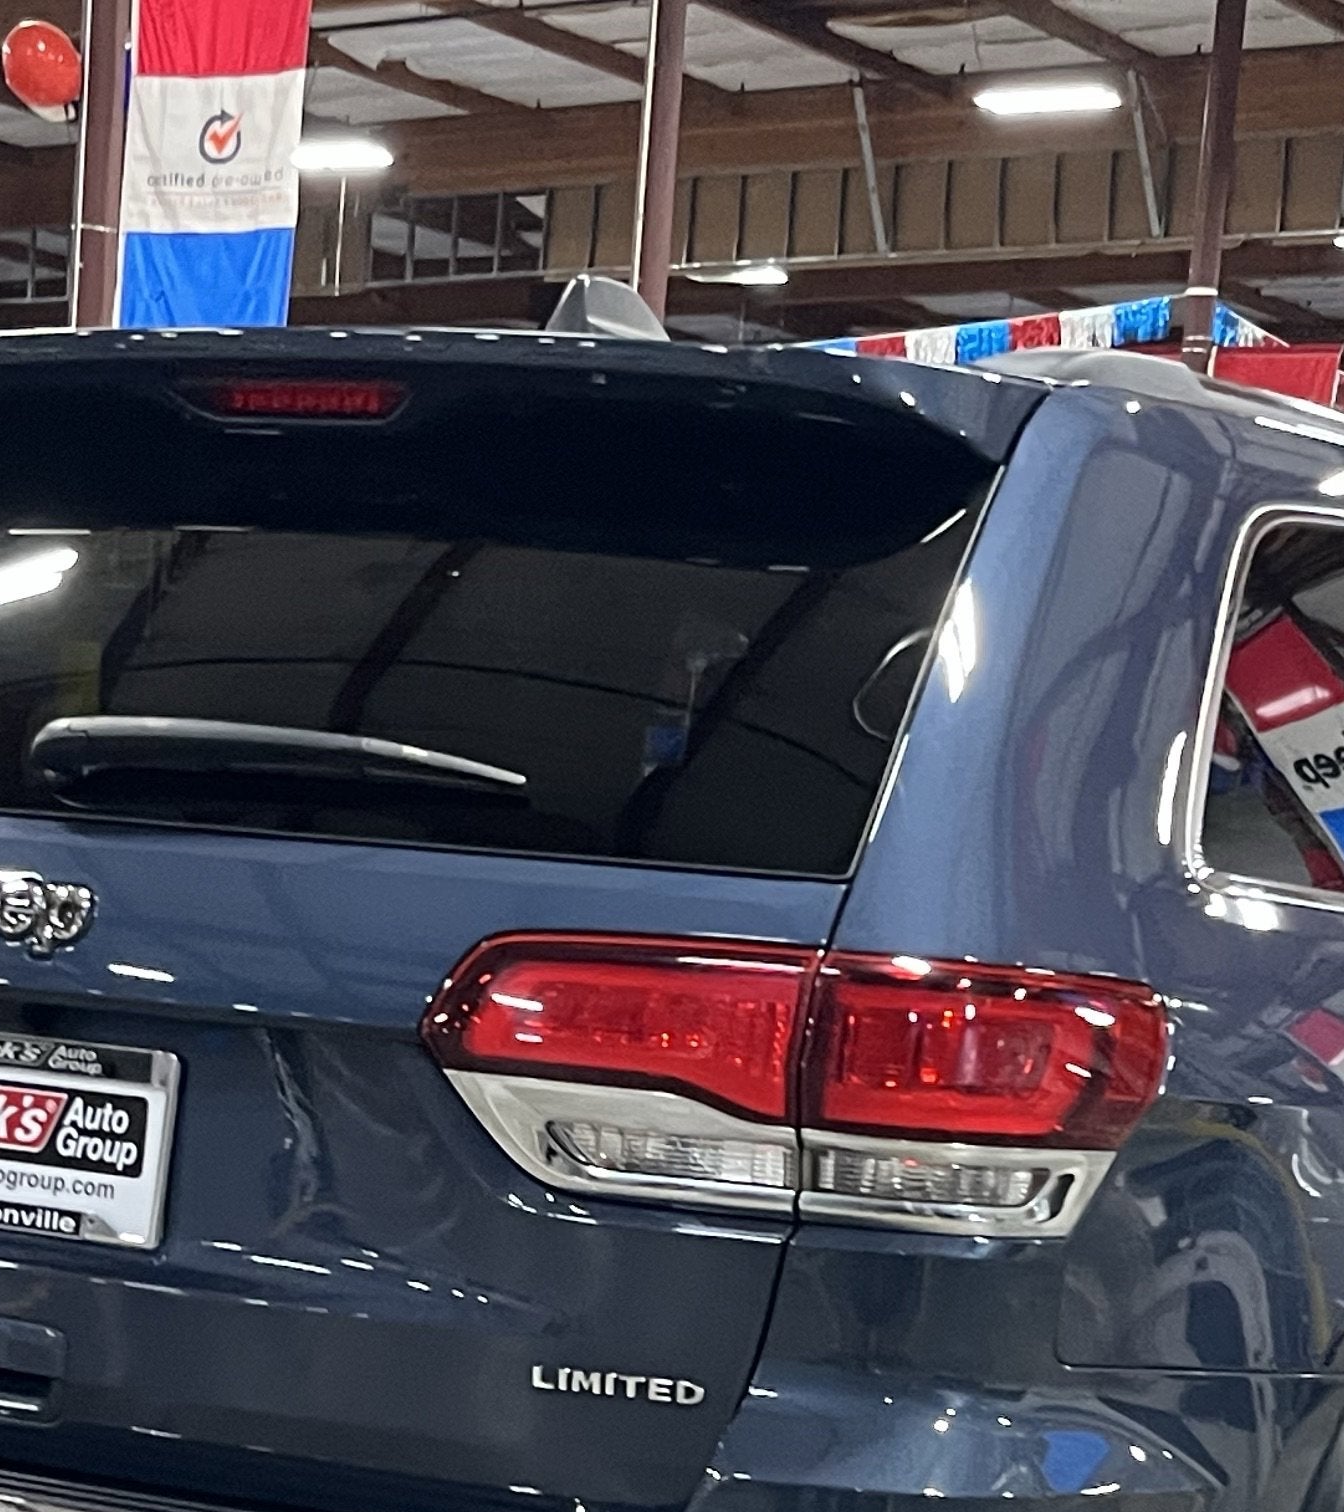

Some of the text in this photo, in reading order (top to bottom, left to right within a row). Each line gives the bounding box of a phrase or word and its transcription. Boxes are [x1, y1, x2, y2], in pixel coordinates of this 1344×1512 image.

[55, 1045, 98, 1062] Auto
[63, 1096, 130, 1135] Auto
[56, 1126, 138, 1171] Group
[532, 1365, 705, 1405] LIMITED
